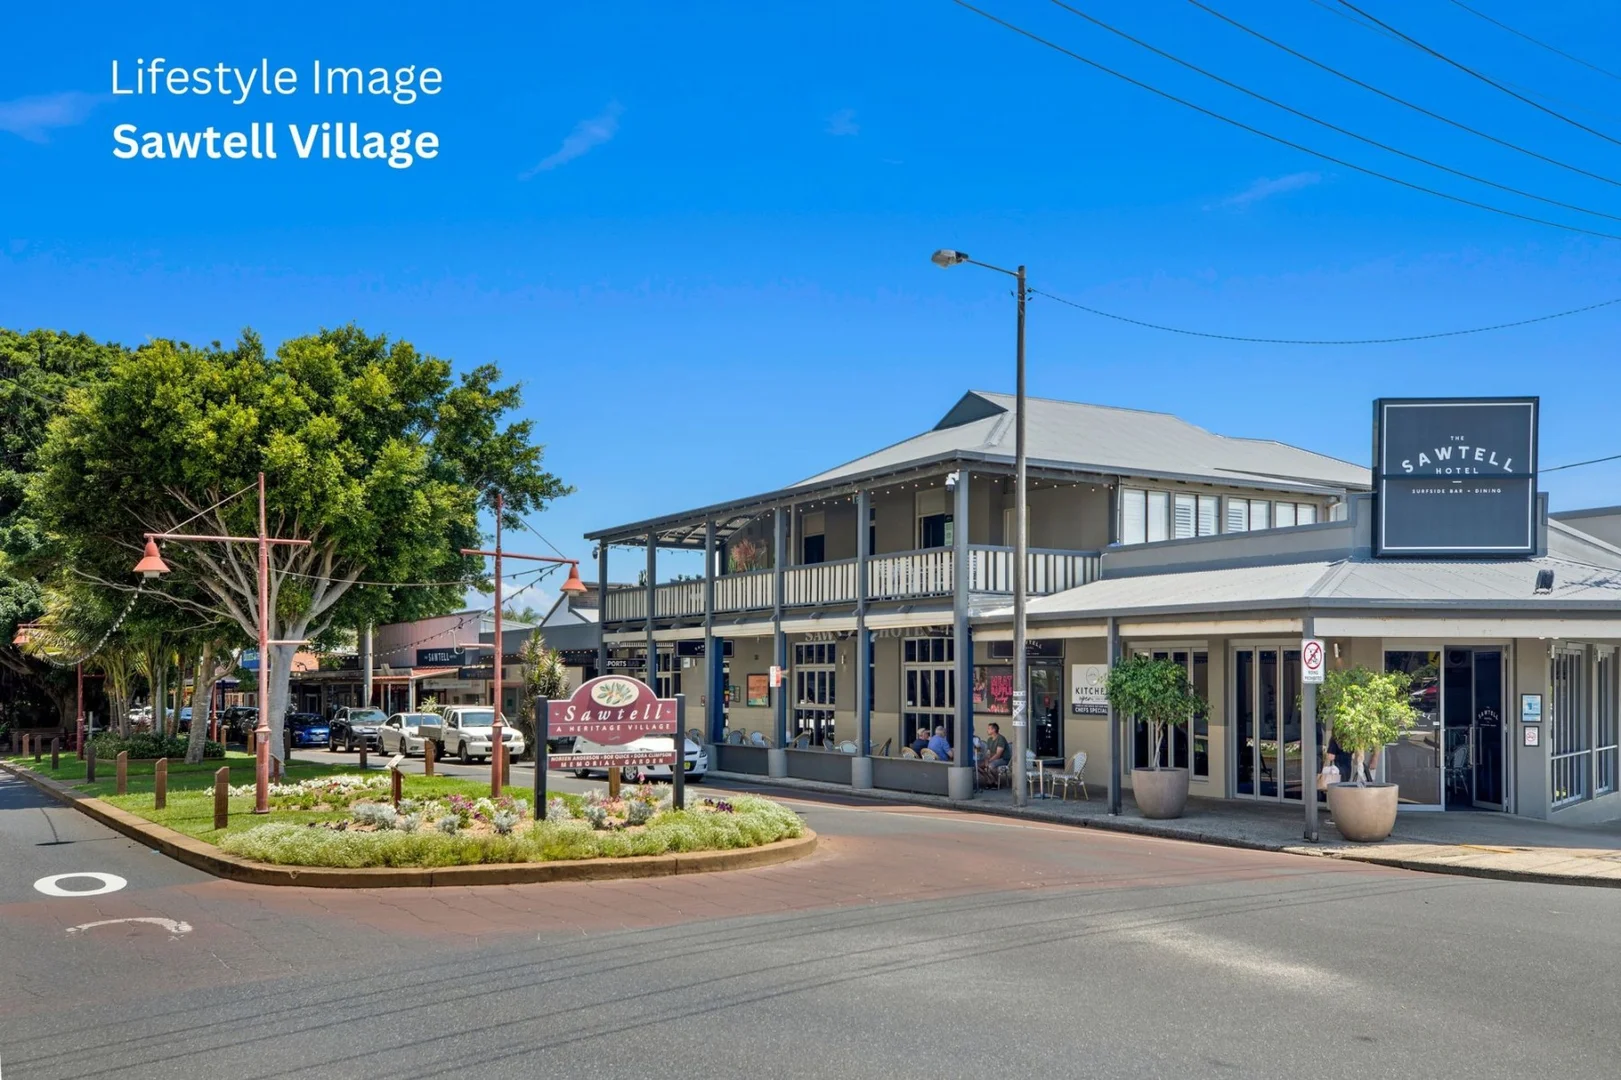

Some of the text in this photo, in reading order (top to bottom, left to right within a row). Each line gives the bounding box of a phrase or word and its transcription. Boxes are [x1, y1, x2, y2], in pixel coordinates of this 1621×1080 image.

[1401, 446, 1514, 473] SAWTELL
[1435, 467, 1479, 475] HOTEL
[428, 652, 450, 662] SAWTELL
[1075, 687, 1105, 695] KITCHE
[564, 704, 663, 722] Sawtell
[561, 760, 616, 768] MEMORIAL
